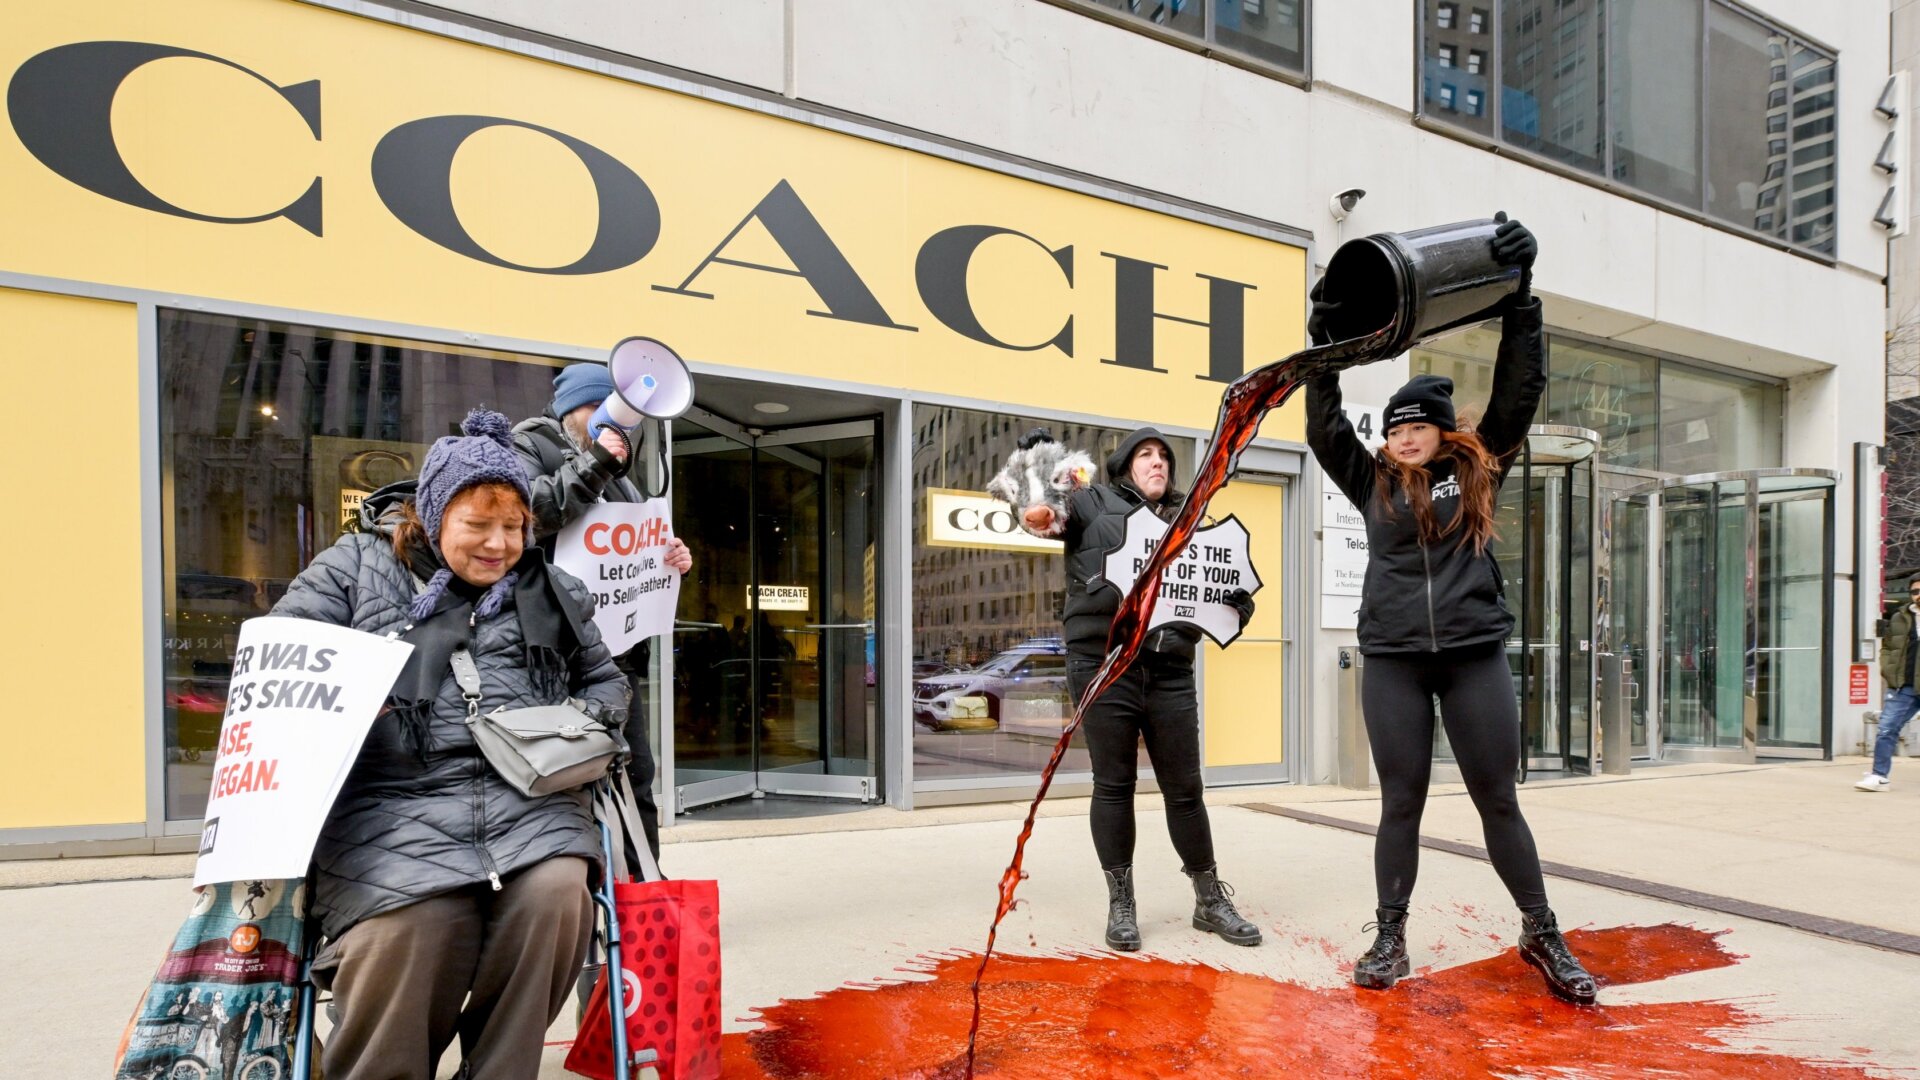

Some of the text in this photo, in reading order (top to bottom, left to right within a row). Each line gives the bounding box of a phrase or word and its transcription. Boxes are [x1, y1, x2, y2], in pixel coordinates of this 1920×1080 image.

[7, 40, 1258, 383] COACH
[948, 507, 1019, 534] CO
[584, 517, 668, 556] COAH:
[1144, 538, 1231, 564] H'S THE
[599, 563, 623, 581] Let
[641, 556, 657, 572] ive.
[1177, 563, 1196, 580] OF
[1203, 565, 1240, 586] YOUR
[592, 575, 672, 609] op Sellin eather!
[748, 587, 808, 598] CACH CREATE
[234, 645, 255, 678] ER
[259, 643, 338, 673] WAS
[226, 679, 345, 718] E'S SKIN.
[218, 721, 252, 759] ASE,
[236, 933, 256, 946] TJ
[214, 963, 243, 972] TRADER
